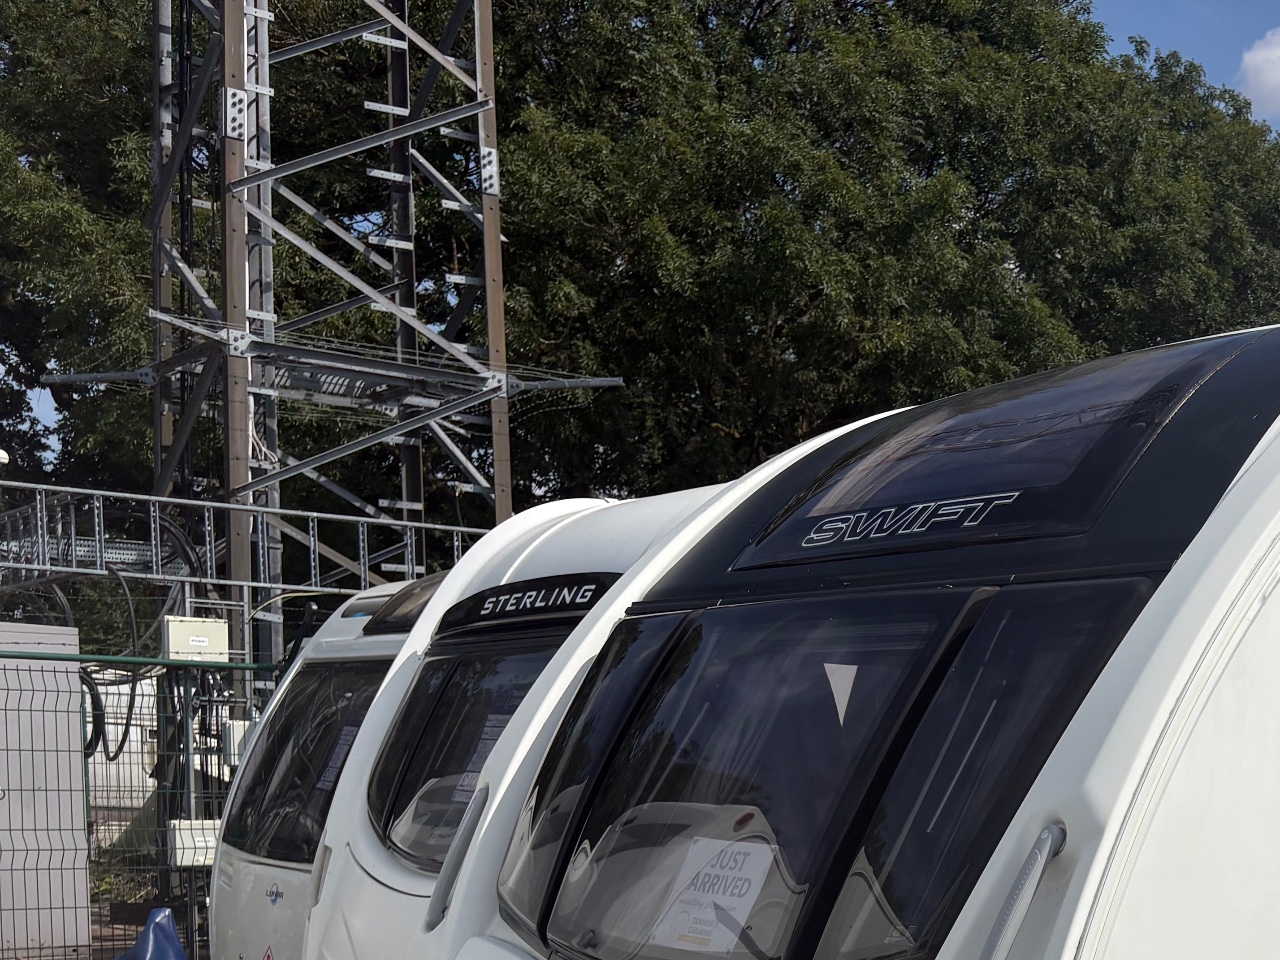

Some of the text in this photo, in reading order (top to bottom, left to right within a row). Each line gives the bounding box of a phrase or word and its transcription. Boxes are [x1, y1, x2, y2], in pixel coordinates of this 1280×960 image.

[801, 489, 1024, 547] SWIFT
[480, 584, 597, 616] STERLING
[710, 848, 752, 872] JUST
[686, 872, 752, 898] ARRIVED
